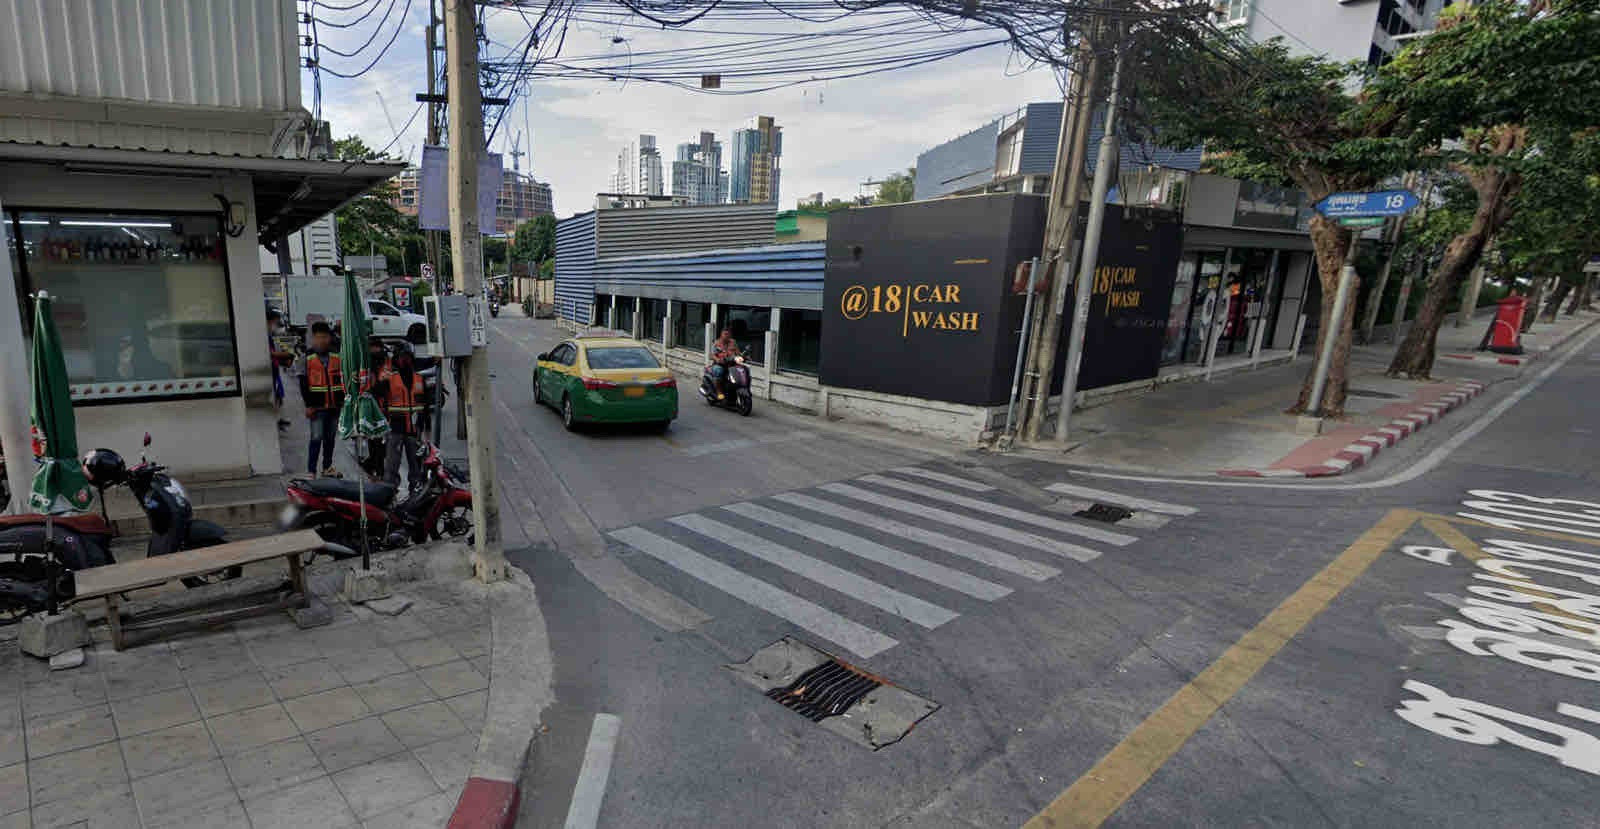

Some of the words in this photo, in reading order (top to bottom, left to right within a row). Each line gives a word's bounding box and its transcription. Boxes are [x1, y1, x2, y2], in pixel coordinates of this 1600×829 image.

[1385, 195, 1404, 208] 18
[1113, 267, 1136, 284] CAR
[841, 284, 902, 320] @18
[913, 284, 961, 303] CAR
[1112, 290, 1141, 308] WASH
[912, 312, 979, 331] WASH
[1456, 489, 1600, 538] 103
